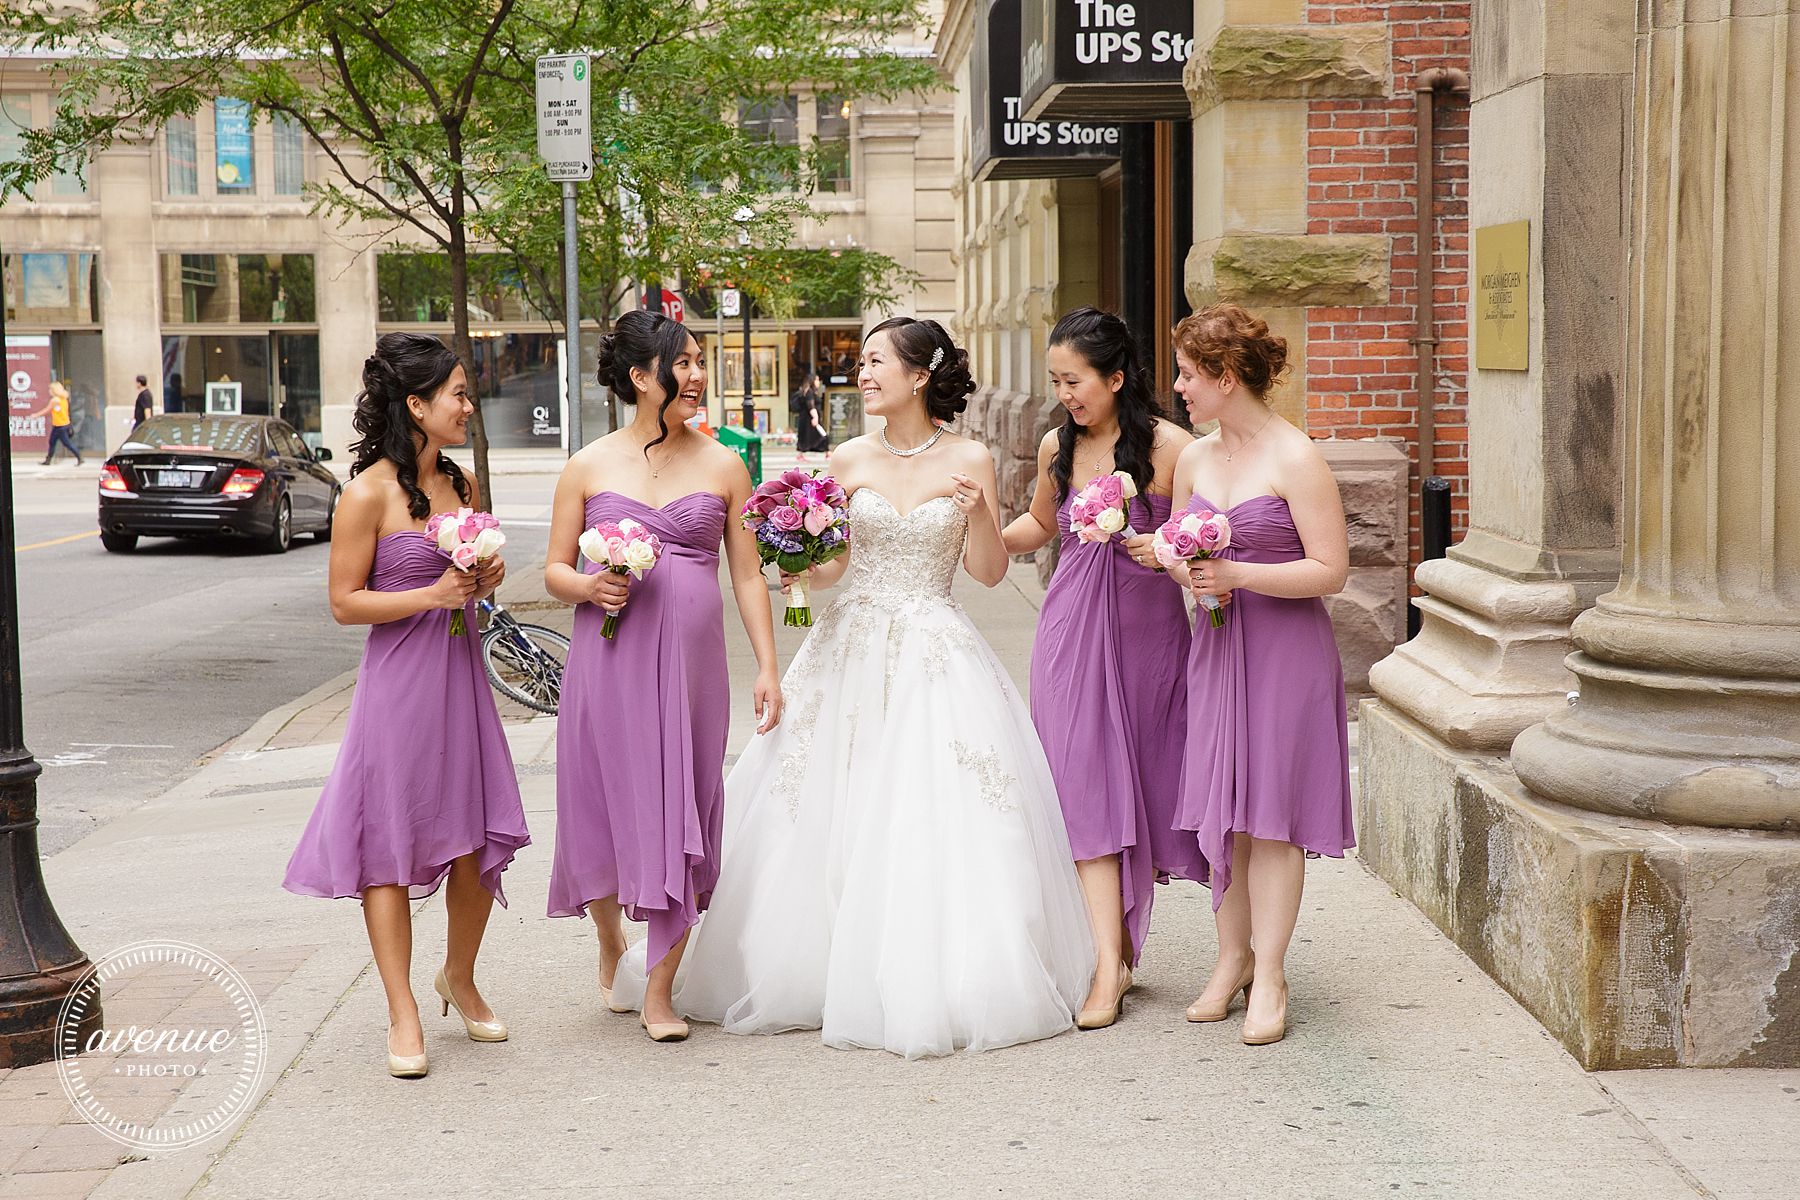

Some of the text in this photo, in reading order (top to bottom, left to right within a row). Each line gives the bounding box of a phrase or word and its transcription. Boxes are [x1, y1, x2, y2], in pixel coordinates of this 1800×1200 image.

[1074, 0, 1136, 27] The
[1075, 32, 1142, 64] UPS
[547, 60, 567, 68] PARKING
[548, 100, 561, 108] MON
[566, 99, 577, 107] SAT
[1003, 121, 1052, 145] UPS
[1057, 121, 1119, 145] Store
[533, 406, 549, 421] Qi
